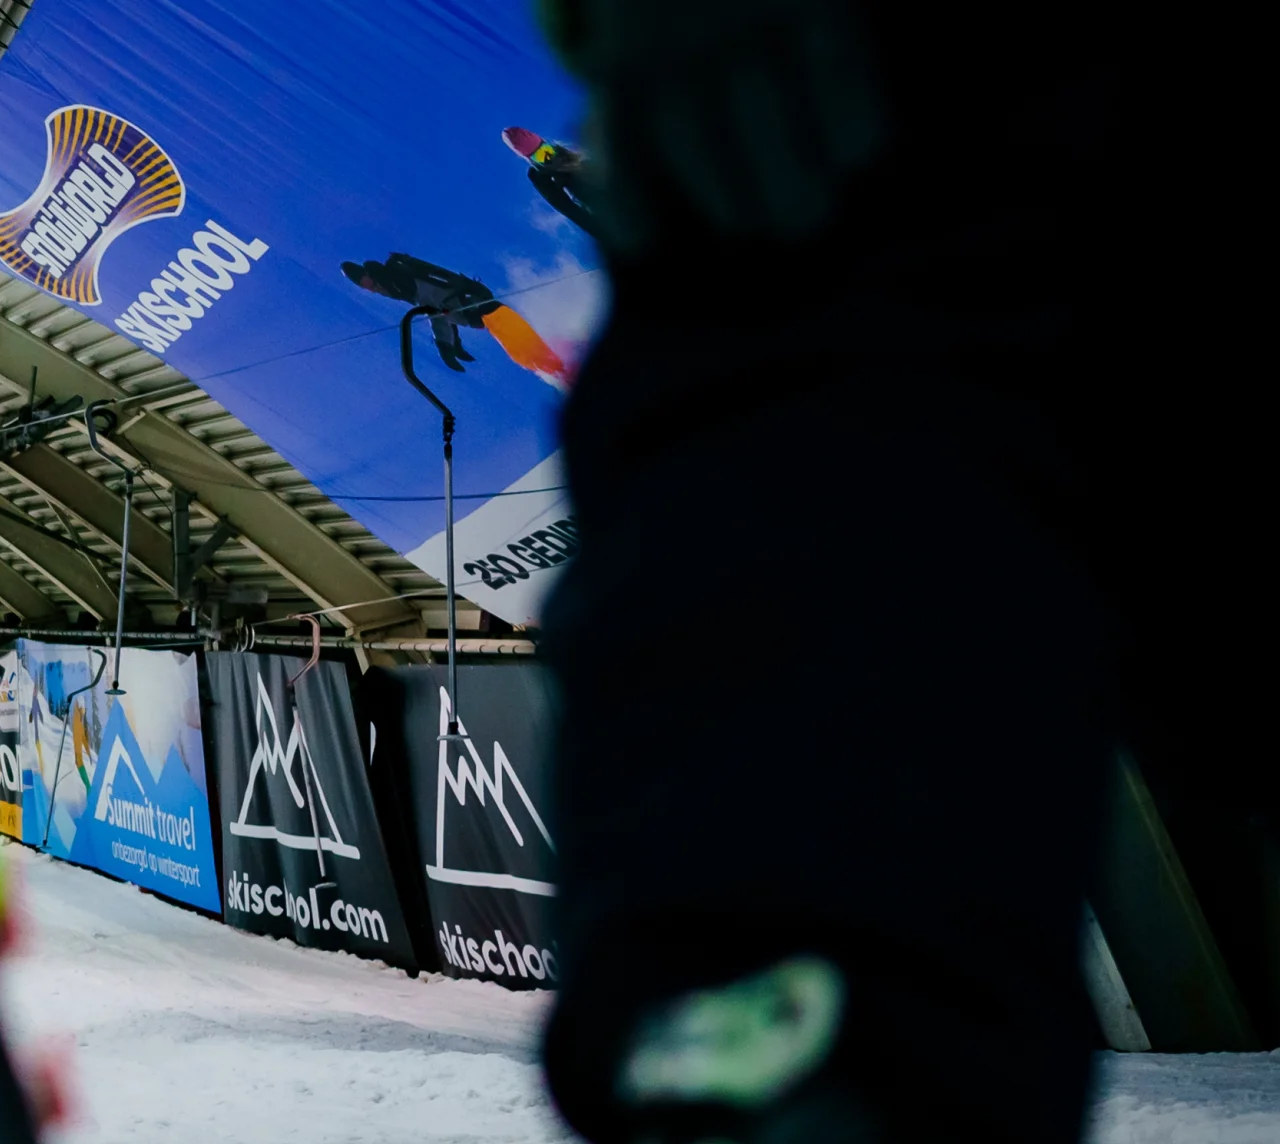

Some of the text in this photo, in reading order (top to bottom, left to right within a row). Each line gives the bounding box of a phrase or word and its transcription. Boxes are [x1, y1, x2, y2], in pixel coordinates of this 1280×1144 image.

[22, 142, 136, 279] SNOWWORLD
[114, 219, 269, 353] SKISCHOOL
[107, 784, 195, 851] Summit travel
[112, 838, 200, 887] onbezorgd op wintersport
